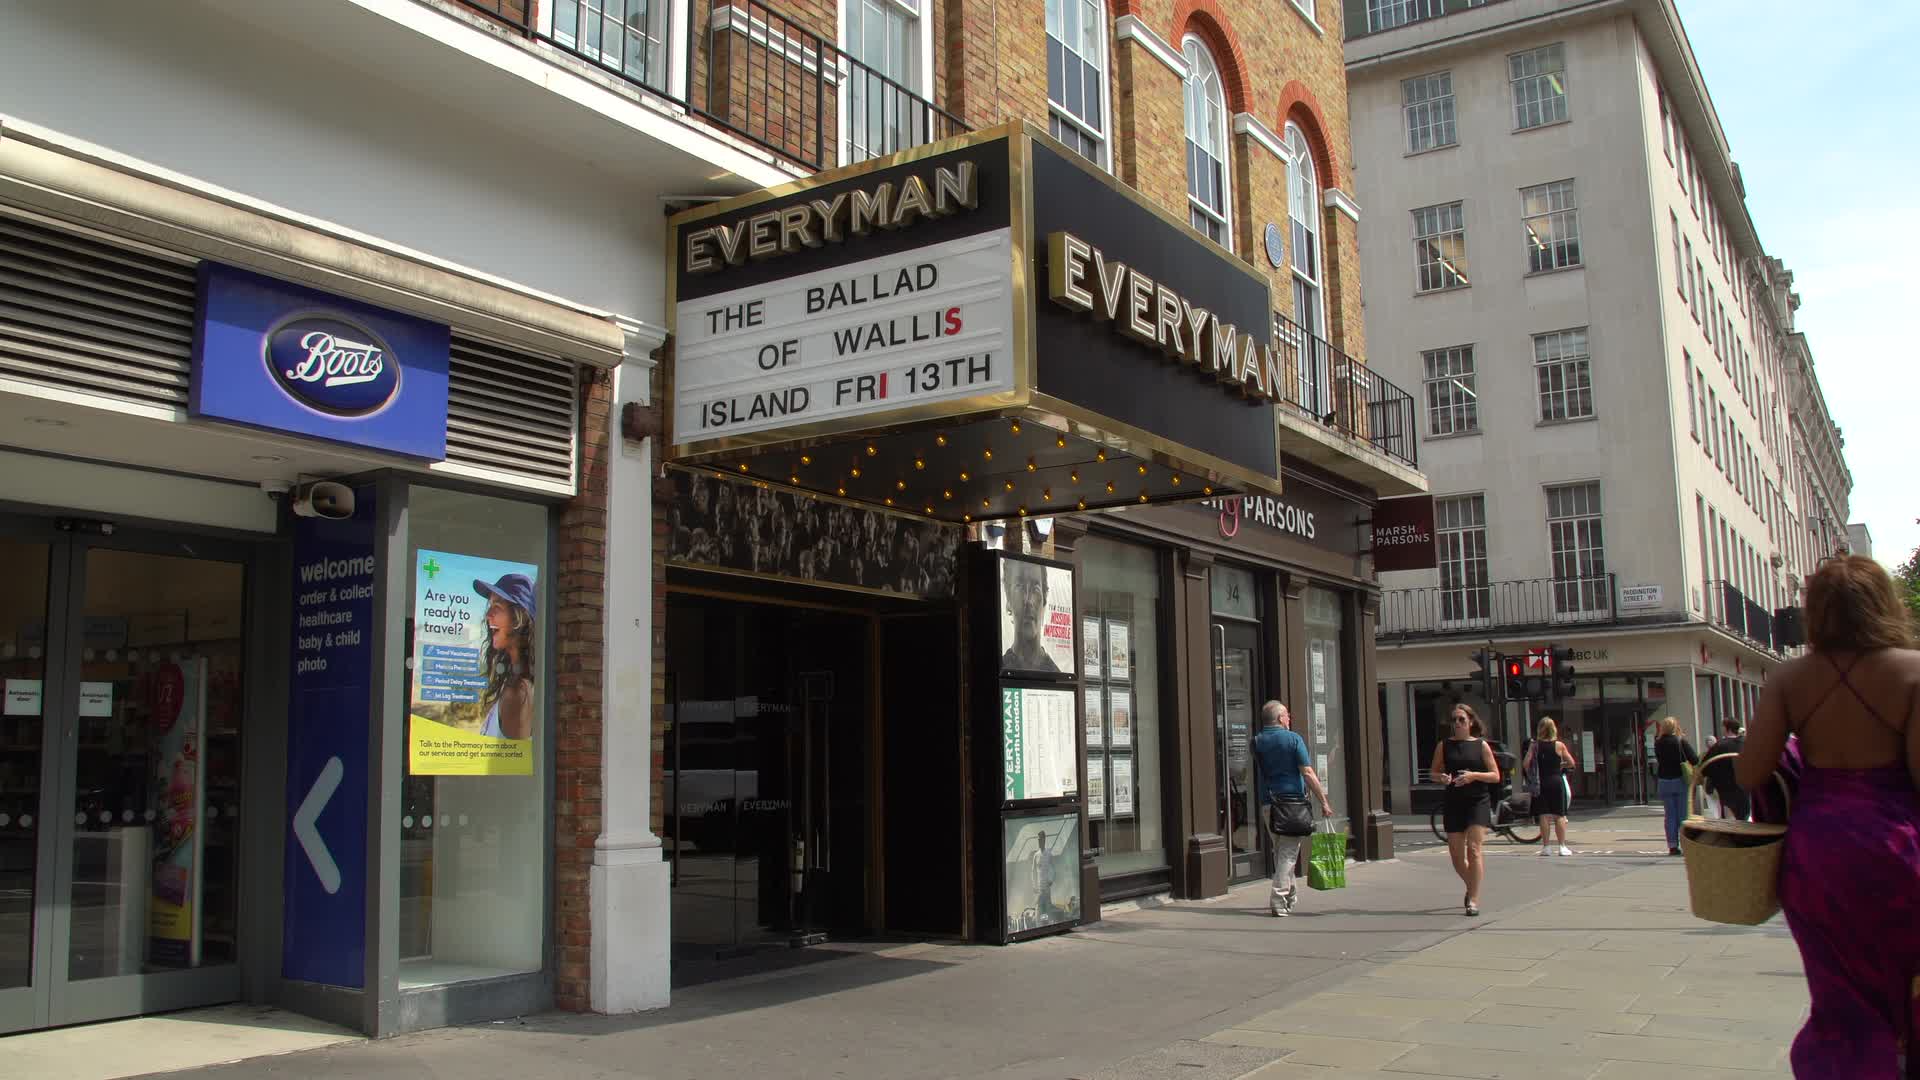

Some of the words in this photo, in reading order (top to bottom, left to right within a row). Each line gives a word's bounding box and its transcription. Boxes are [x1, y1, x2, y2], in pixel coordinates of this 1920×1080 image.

[686, 160, 979, 273] EVERYMAN
[706, 300, 764, 335] THE
[806, 263, 938, 314] BALLAD
[1050, 231, 1284, 401] EVERYMAN
[758, 340, 799, 371] OF
[834, 306, 962, 357] WALLIS
[285, 331, 384, 387] Boots
[702, 386, 810, 429] ISLAND
[835, 372, 888, 406] FRI
[905, 354, 991, 394] 13TH
[1244, 496, 1315, 539] PARSONS
[1376, 524, 1416, 537] MARSH
[1376, 533, 1431, 547] PARSONS
[300, 555, 375, 583] welcome
[300, 590, 328, 605] order
[330, 588, 337, 601] &
[424, 588, 446, 602] Are
[449, 594, 469, 606] you
[1623, 587, 1657, 596] PADDINGTON
[299, 611, 352, 628] healthcare
[424, 606, 456, 622] ready
[458, 609, 470, 620] to
[424, 622, 464, 635] travel?
[299, 634, 322, 651] baby
[325, 633, 333, 647] &
[335, 630, 360, 646] child
[1593, 647, 1608, 661] UK
[298, 657, 327, 674] photo
[419, 740, 432, 748] Talk
[434, 740, 441, 748] to
[442, 740, 452, 748] the
[453, 740, 483, 751] Pharmacy
[500, 742, 517, 750] about
[456, 749, 468, 757] and
[469, 750, 479, 759] get
[1004, 691, 1015, 800] EVERYMAN
[743, 799, 792, 811] EVERYMAN
